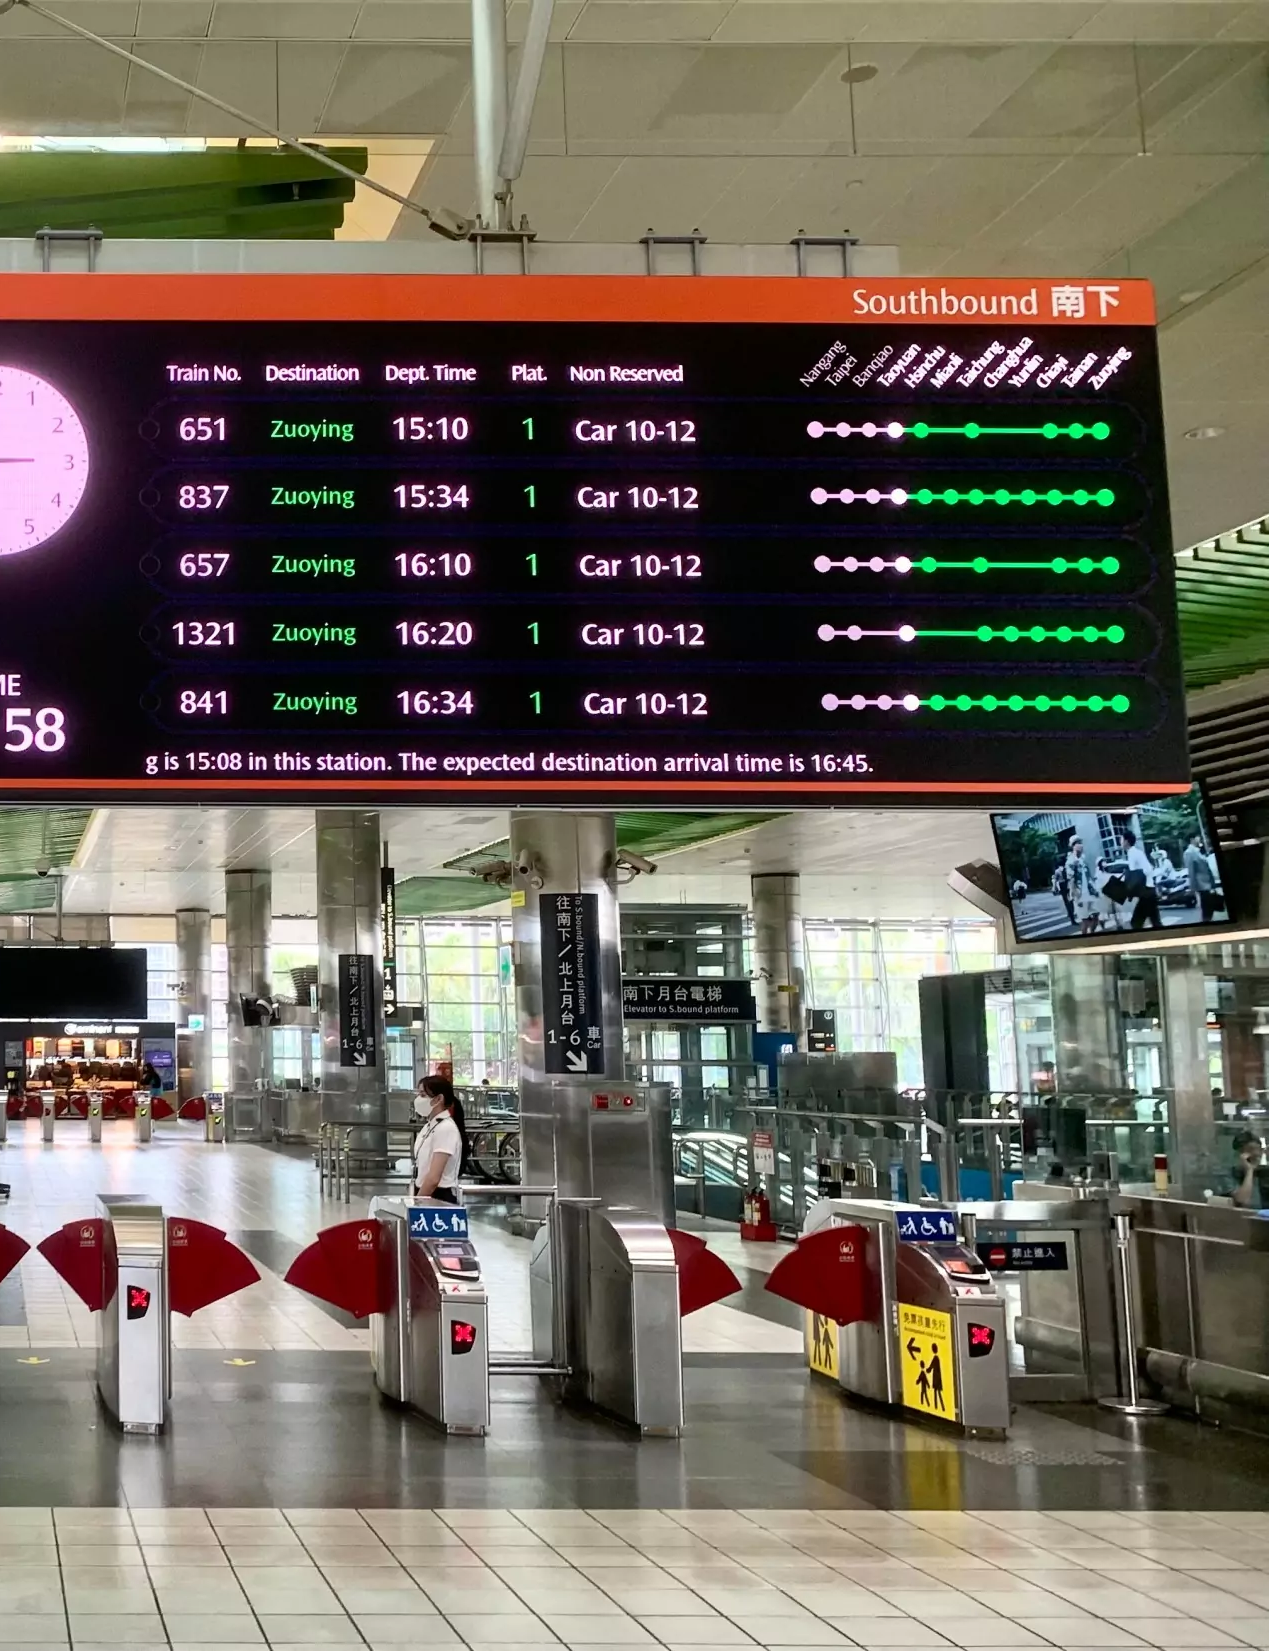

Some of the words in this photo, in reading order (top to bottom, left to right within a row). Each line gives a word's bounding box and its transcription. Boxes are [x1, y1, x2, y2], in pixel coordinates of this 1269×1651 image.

[853, 287, 1037, 315] Southbound
[1051, 285, 1120, 318] 南下
[166, 364, 209, 381] Train
[214, 365, 241, 381] No.
[266, 364, 359, 381] Destination
[386, 365, 429, 384] Dept.
[433, 364, 476, 380] Time
[512, 364, 547, 381] Plat.
[570, 366, 605, 381] Non
[610, 365, 683, 381] Reserved
[800, 340, 847, 388] Nangang
[824, 353, 858, 389] Taipei
[852, 344, 893, 388] Banqiao
[876, 343, 922, 389] Taoyuan
[180, 418, 226, 441] 651
[271, 419, 353, 441] Zuoying
[393, 417, 468, 440] 15:10
[576, 420, 617, 441] Car
[626, 420, 696, 441] 10-12
[180, 485, 229, 508] 837
[272, 486, 354, 508] Zuoying
[394, 485, 469, 507] 15:34
[578, 487, 619, 508] Car
[628, 487, 698, 508] 10-12
[180, 554, 229, 576] 657
[272, 554, 355, 577] Zuoying
[395, 553, 471, 576] 16:10
[580, 555, 621, 576] Car
[631, 555, 701, 576] 10-12
[181, 691, 228, 714] 841
[274, 692, 357, 714] Zuoying
[397, 691, 473, 714] 16:34
[584, 693, 627, 714] Car
[636, 693, 707, 714] 10-12
[165, 752, 179, 770] is
[186, 753, 242, 770] 15:08
[249, 752, 267, 770] in
[274, 752, 311, 770] this
[317, 752, 392, 770] station.
[398, 752, 437, 770] The
[443, 752, 534, 775] expected
[542, 753, 657, 771] destination
[664, 753, 729, 771] arrival
[735, 754, 783, 772] time
[789, 754, 805, 772] is
[811, 755, 873, 772] 16:45.
[575, 896, 583, 905] To
[384, 968, 391, 980] 1
[578, 981, 587, 1015] platform
[623, 985, 722, 1001] 南下月台電梯
[624, 1005, 657, 1013] Elevator
[659, 1005, 667, 1013] to
[669, 1005, 702, 1013] S.bound
[705, 1005, 739, 1014] platform
[587, 1026, 601, 1040] 車
[587, 1041, 601, 1049] Car
